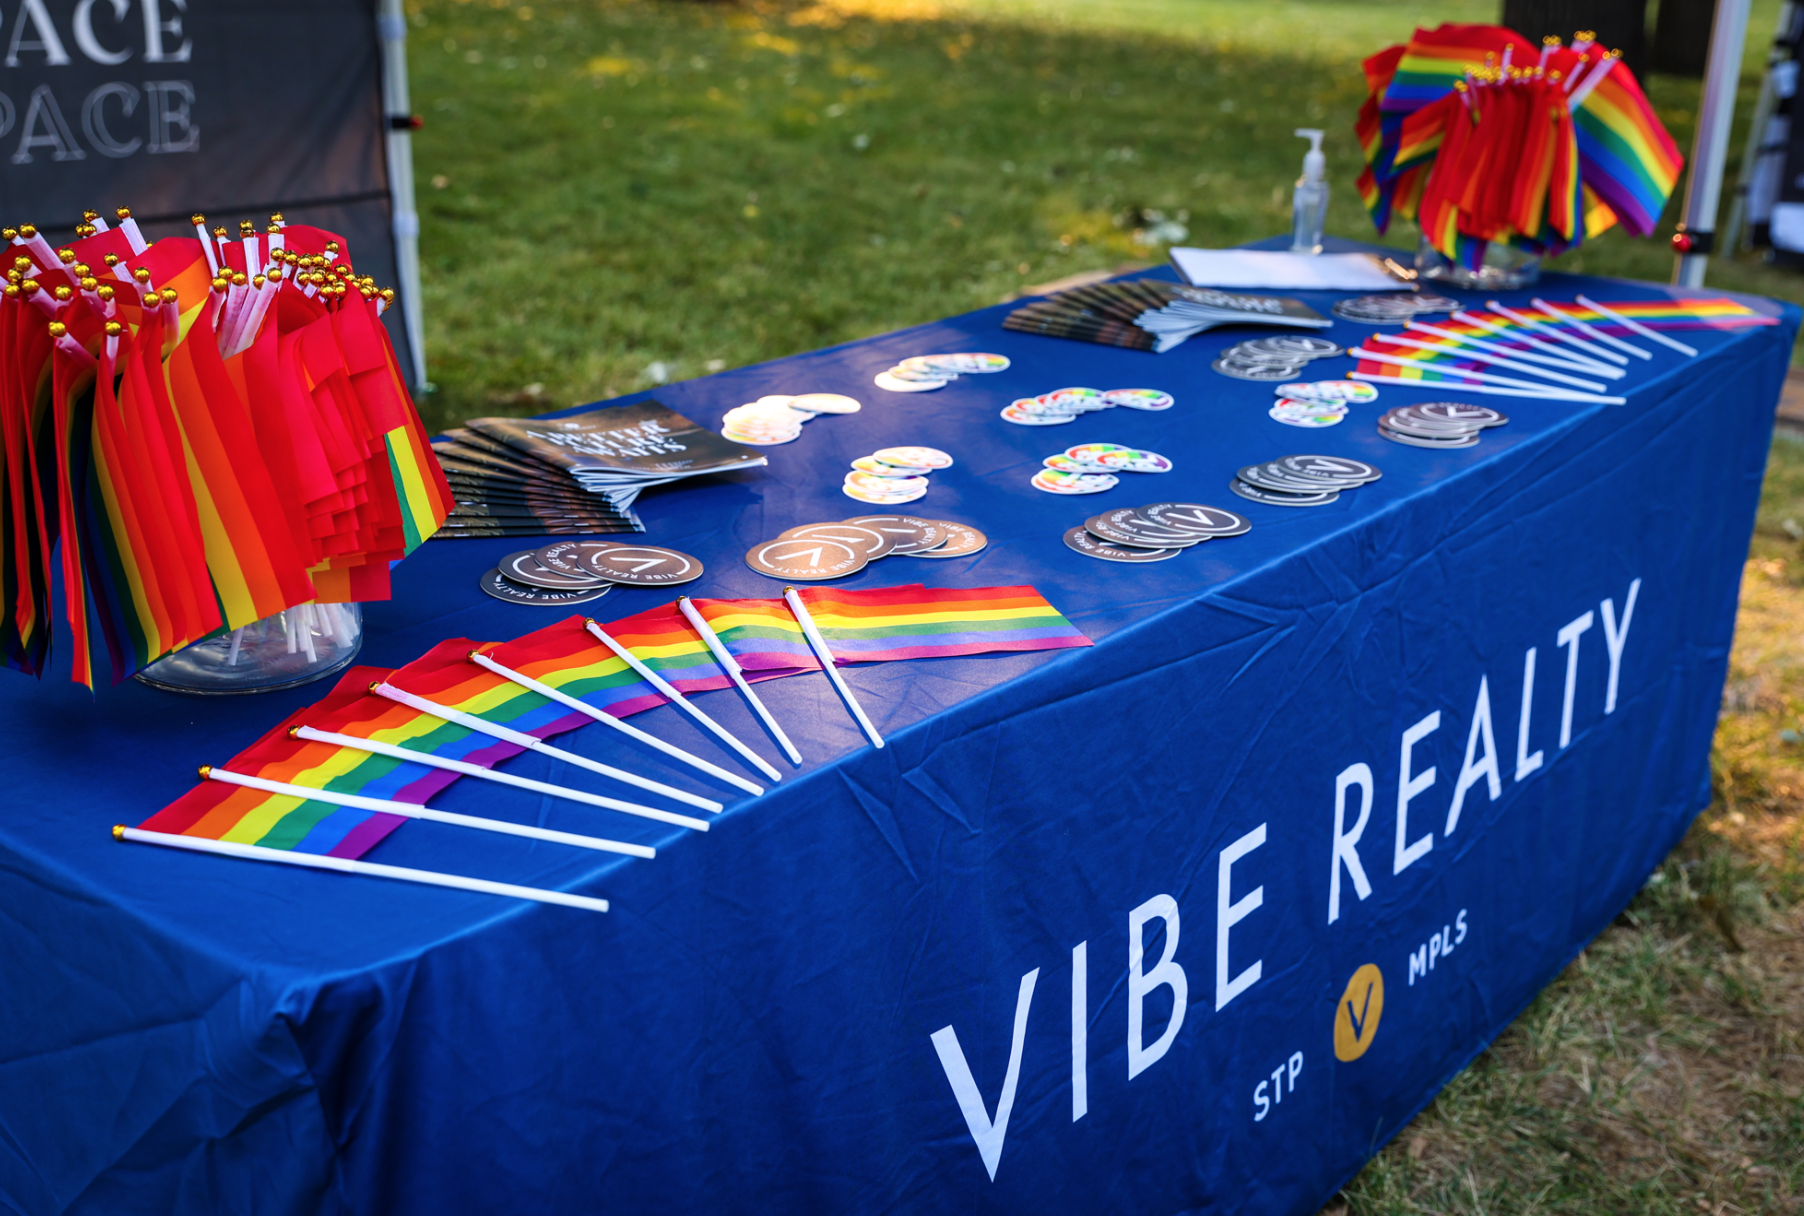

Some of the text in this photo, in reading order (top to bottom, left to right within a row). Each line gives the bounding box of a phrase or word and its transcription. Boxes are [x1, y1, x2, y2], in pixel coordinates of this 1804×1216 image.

[0, 0, 193, 67] ACE
[903, 517, 929, 528] VIBE
[939, 522, 966, 532] VIBE
[546, 543, 577, 570] VIBE REALTY
[1094, 548, 1127, 558] VIBE
[591, 564, 638, 580] REALTY
[773, 559, 856, 575] VIBE REALTY
[493, 582, 577, 600] VIBE REALTY
[930, 578, 1641, 1182] VIBE REALTY
[1253, 1051, 1304, 1122] STP
[1408, 908, 1468, 987] MPLS
